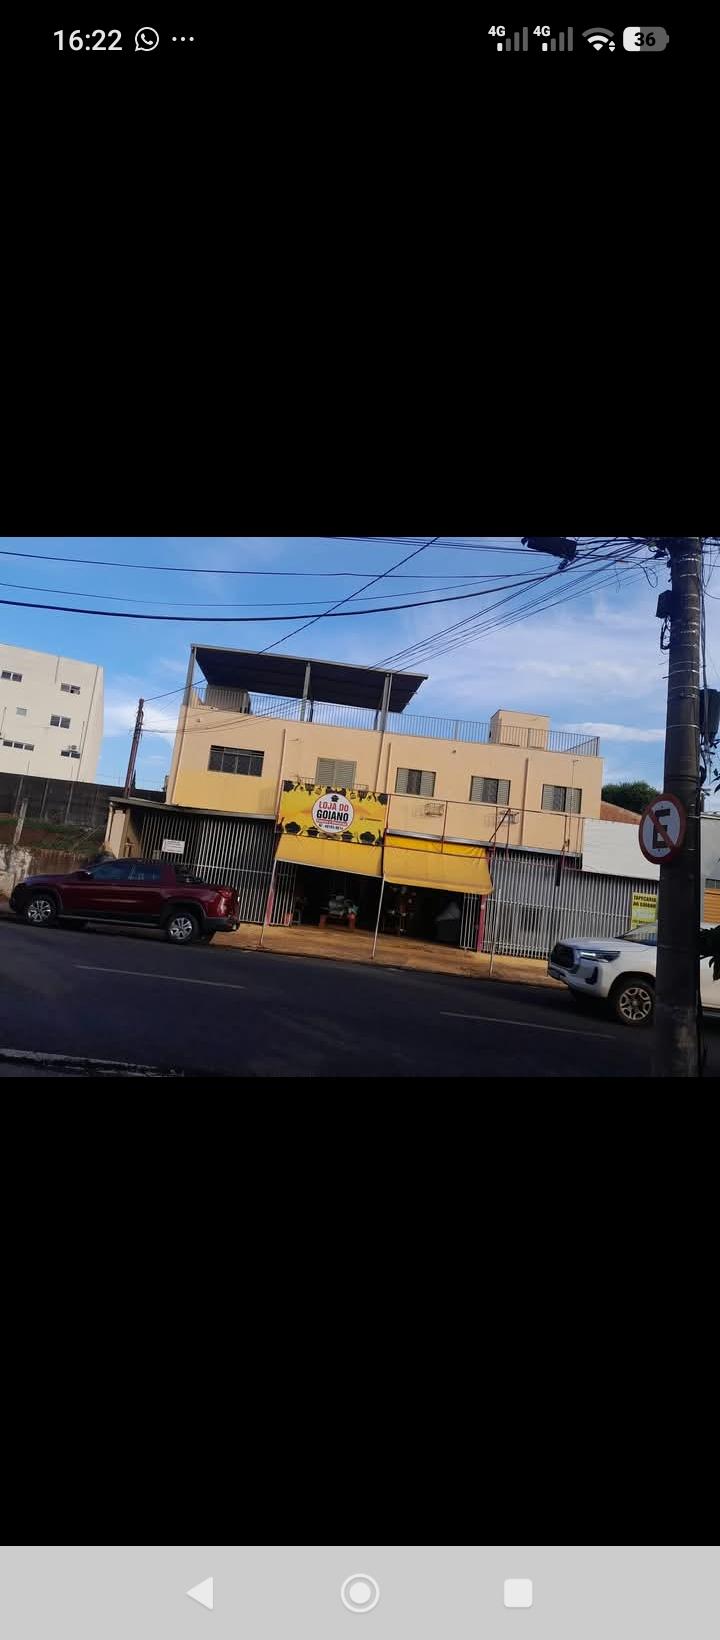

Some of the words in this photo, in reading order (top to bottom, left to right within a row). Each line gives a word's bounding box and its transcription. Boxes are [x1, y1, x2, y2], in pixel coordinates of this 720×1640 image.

[319, 801, 336, 811] LOJA
[339, 803, 349, 811] DO
[316, 810, 349, 821] GOIANO
[652, 809, 671, 849] E
